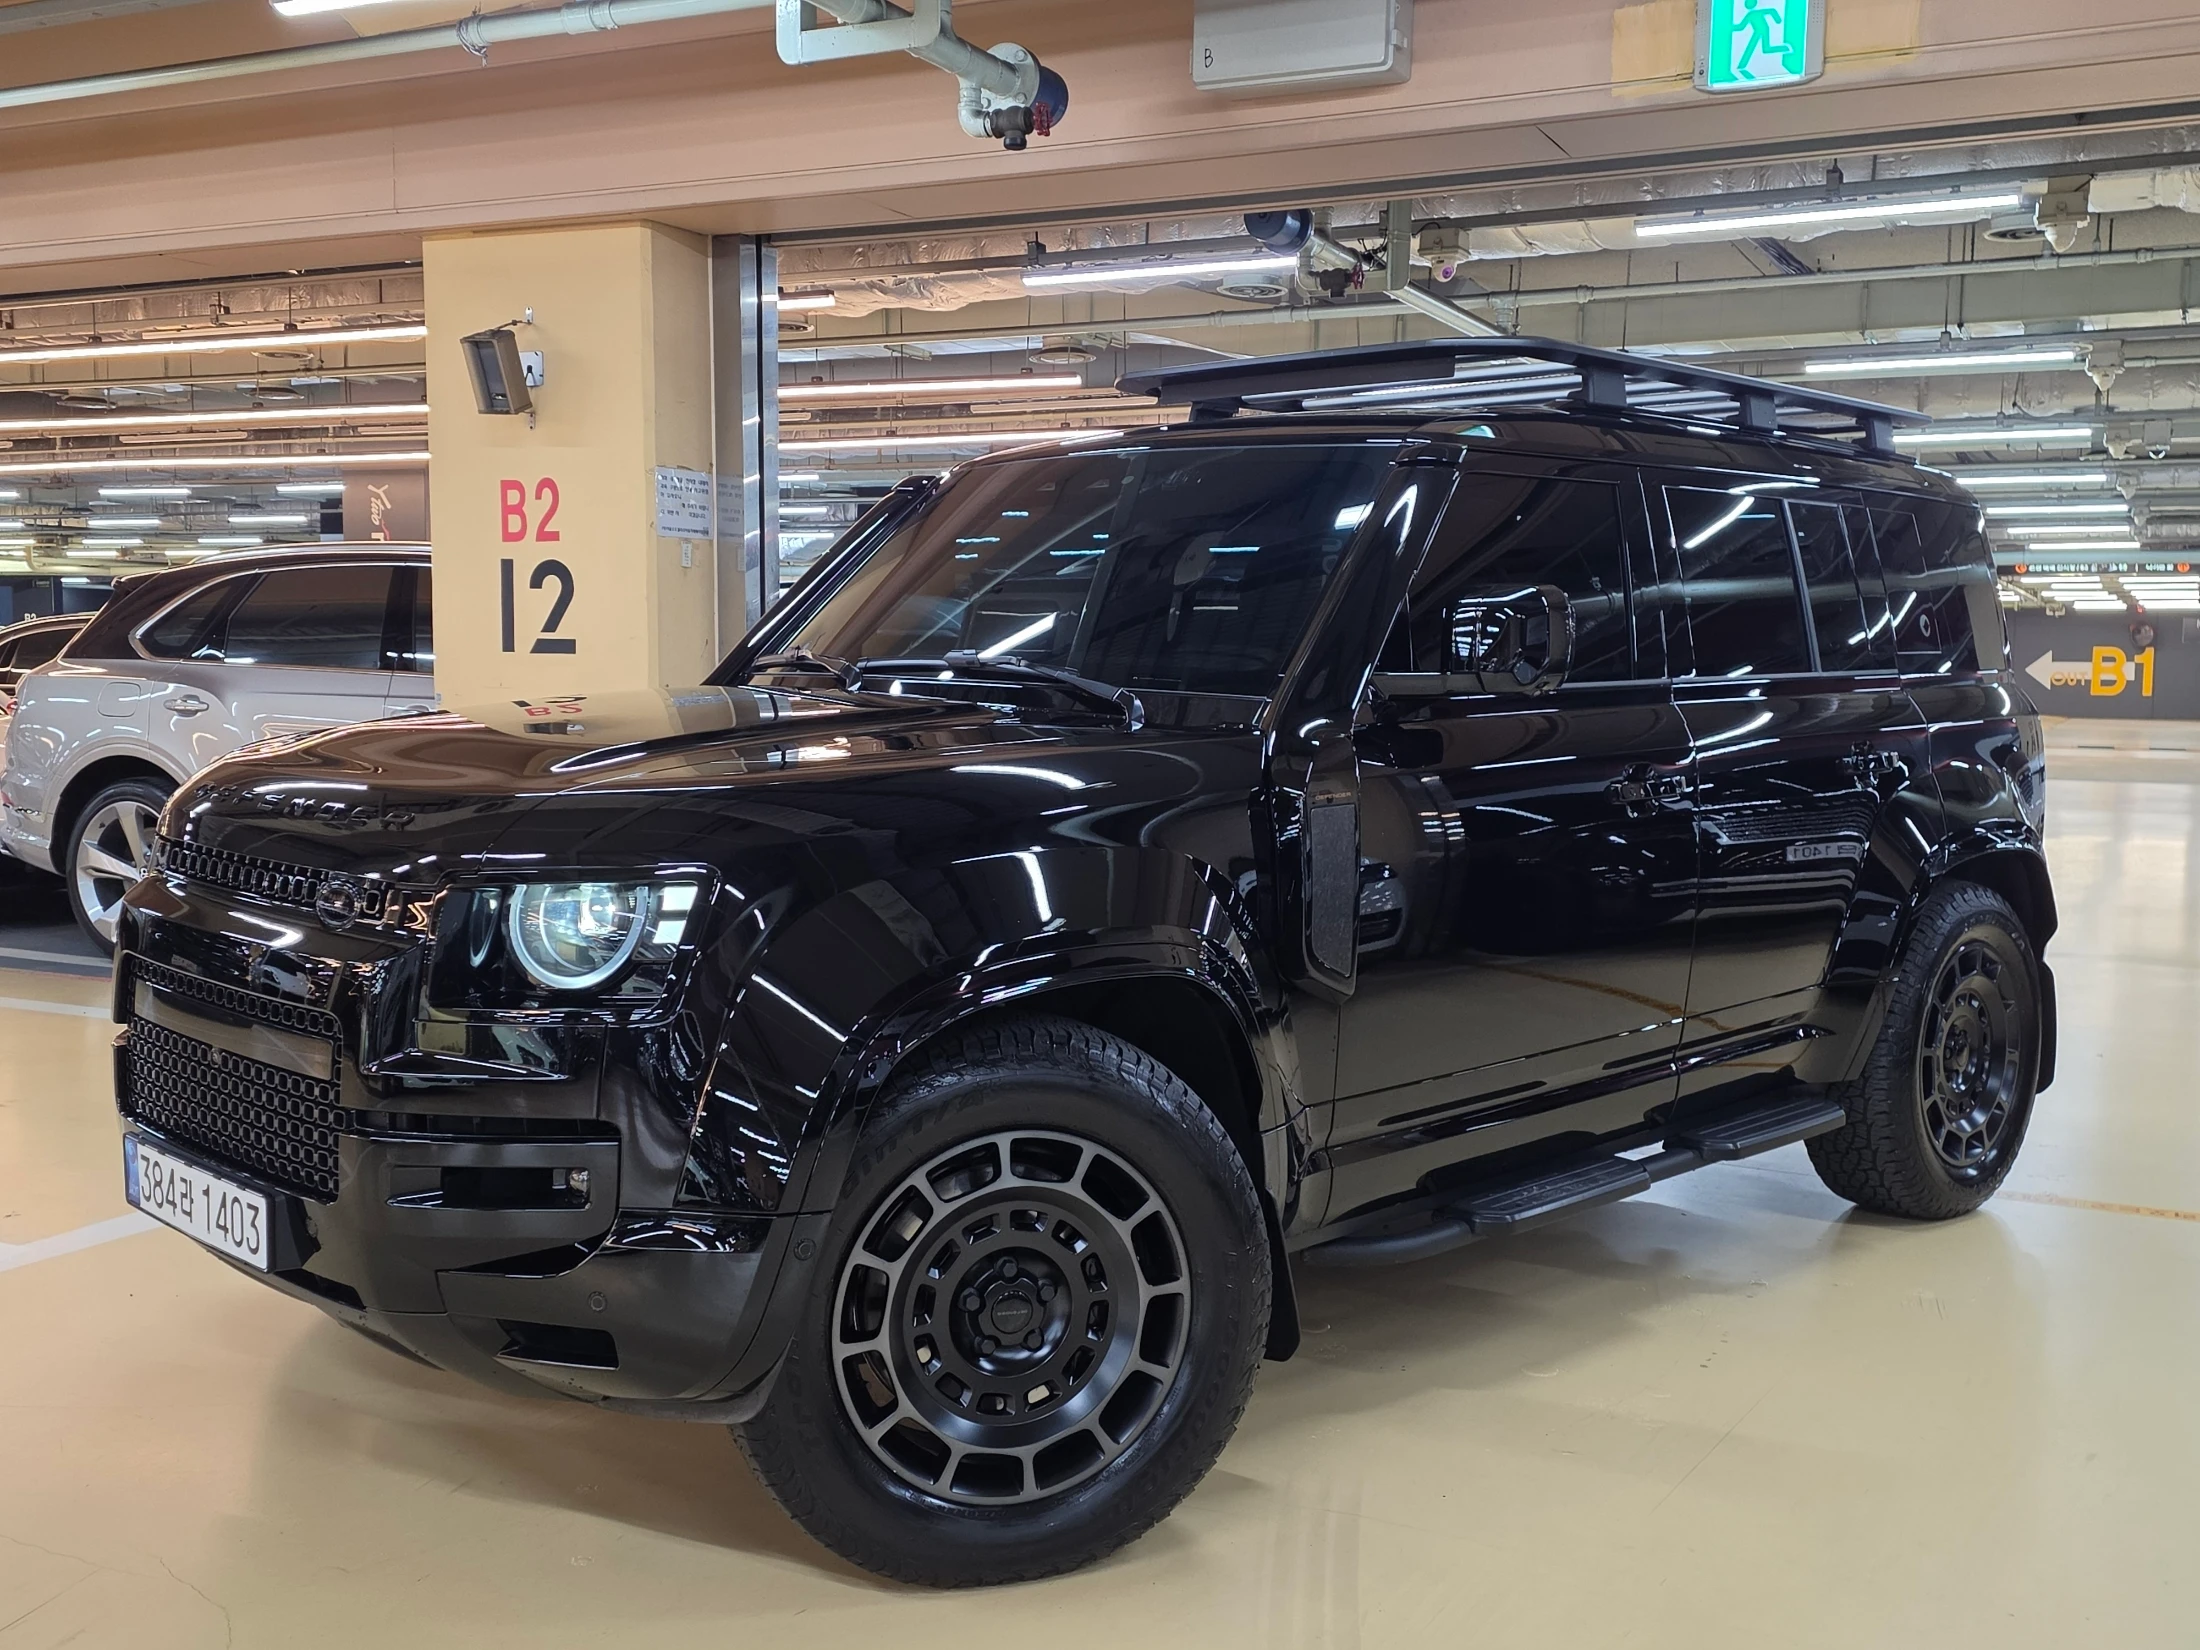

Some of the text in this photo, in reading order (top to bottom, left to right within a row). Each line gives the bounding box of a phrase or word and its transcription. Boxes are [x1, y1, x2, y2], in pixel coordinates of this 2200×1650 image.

[1204, 48, 1214, 69] B
[500, 477, 560, 542] B2
[500, 558, 577, 654] 12
[2051, 645, 2155, 697] OUT B1
[1315, 791, 1352, 801] DEFENDER
[140, 1154, 260, 1256] 384라 1403
